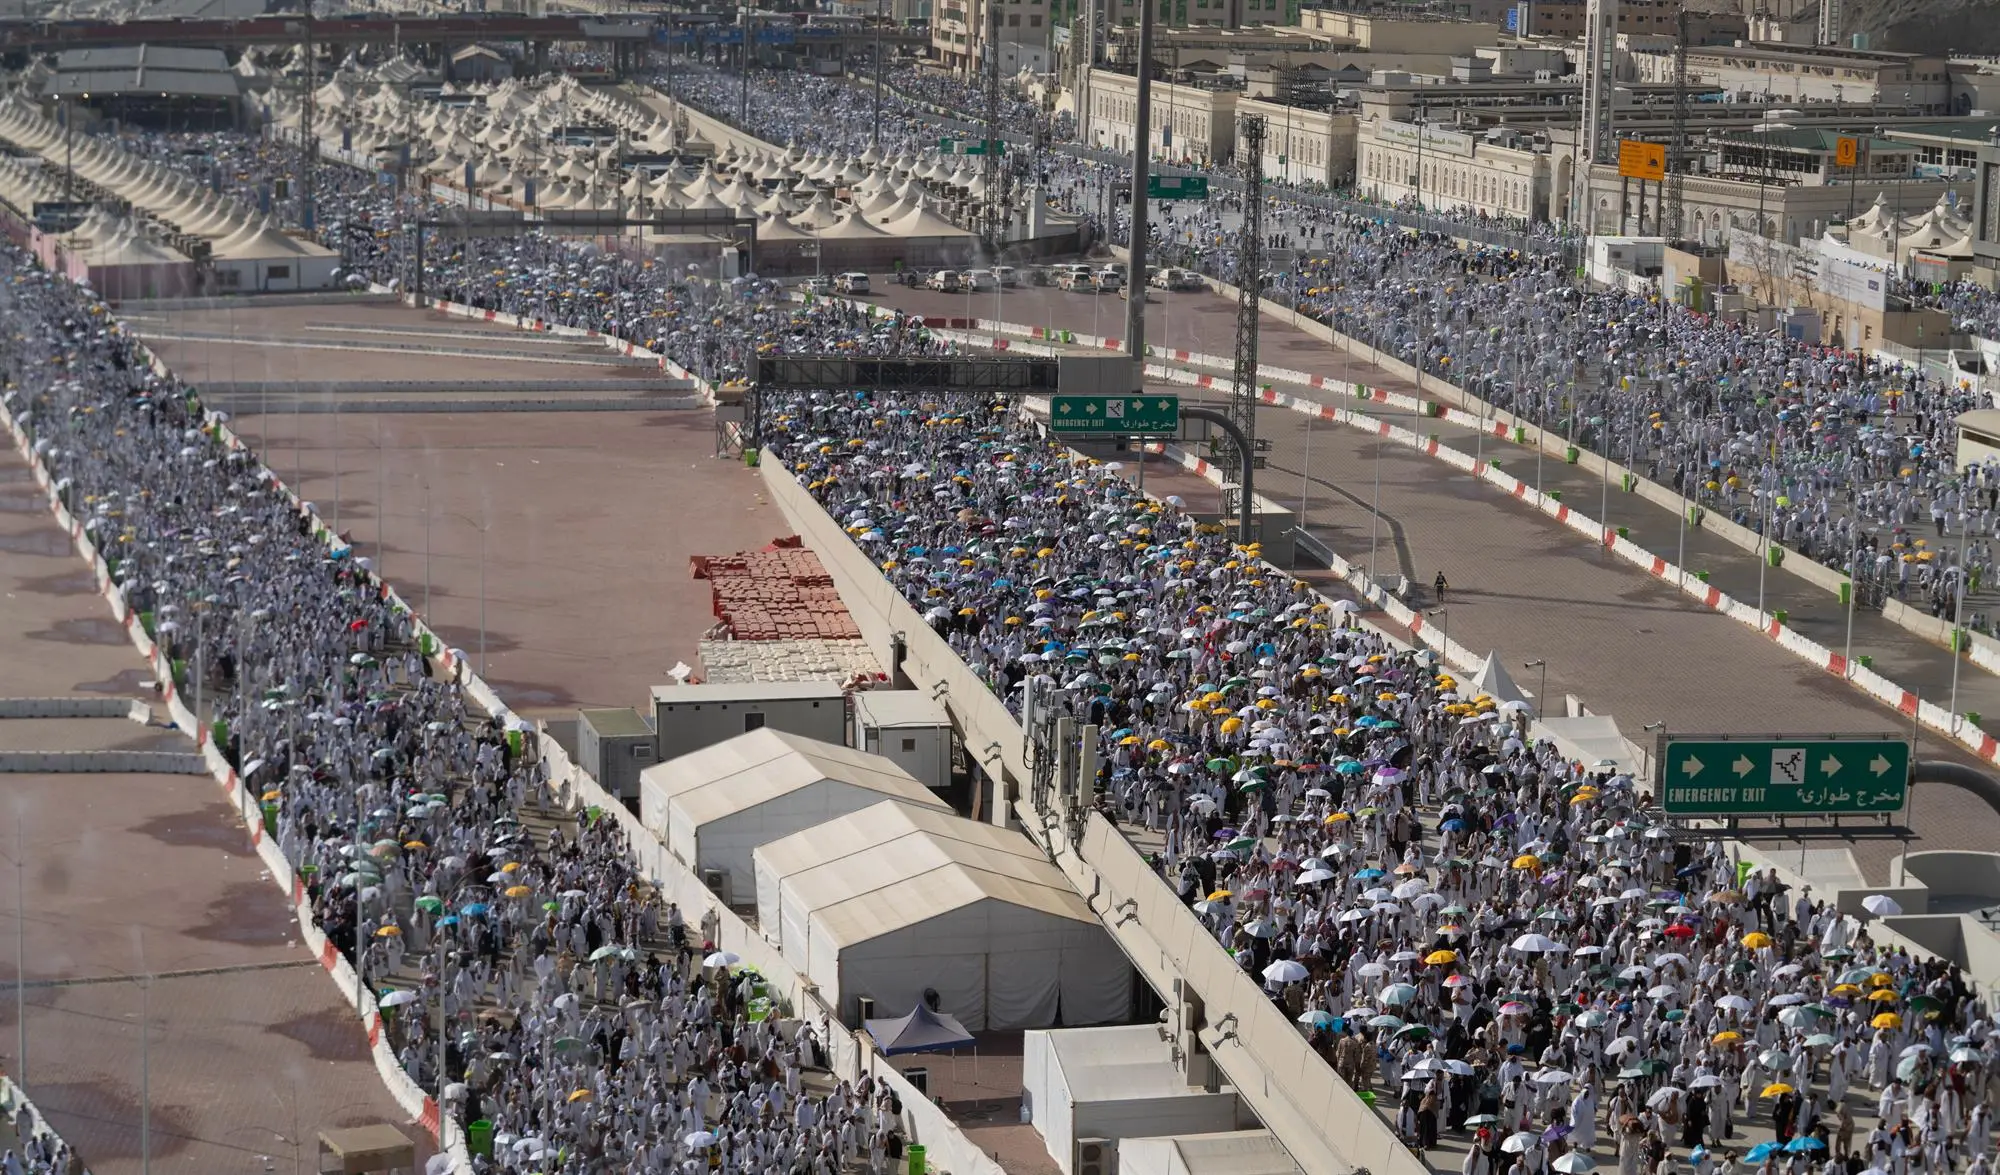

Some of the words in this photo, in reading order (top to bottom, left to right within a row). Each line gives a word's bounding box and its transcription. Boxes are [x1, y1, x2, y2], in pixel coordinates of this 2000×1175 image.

[1053, 418, 1090, 427] EMERGENCY
[1092, 418, 1105, 427] EXIT
[1152, 419, 1176, 430] مخرج
[1668, 787, 1737, 803] EMERGENCY
[1742, 787, 1766, 803] EXIT
[1856, 787, 1901, 807] مخرج
